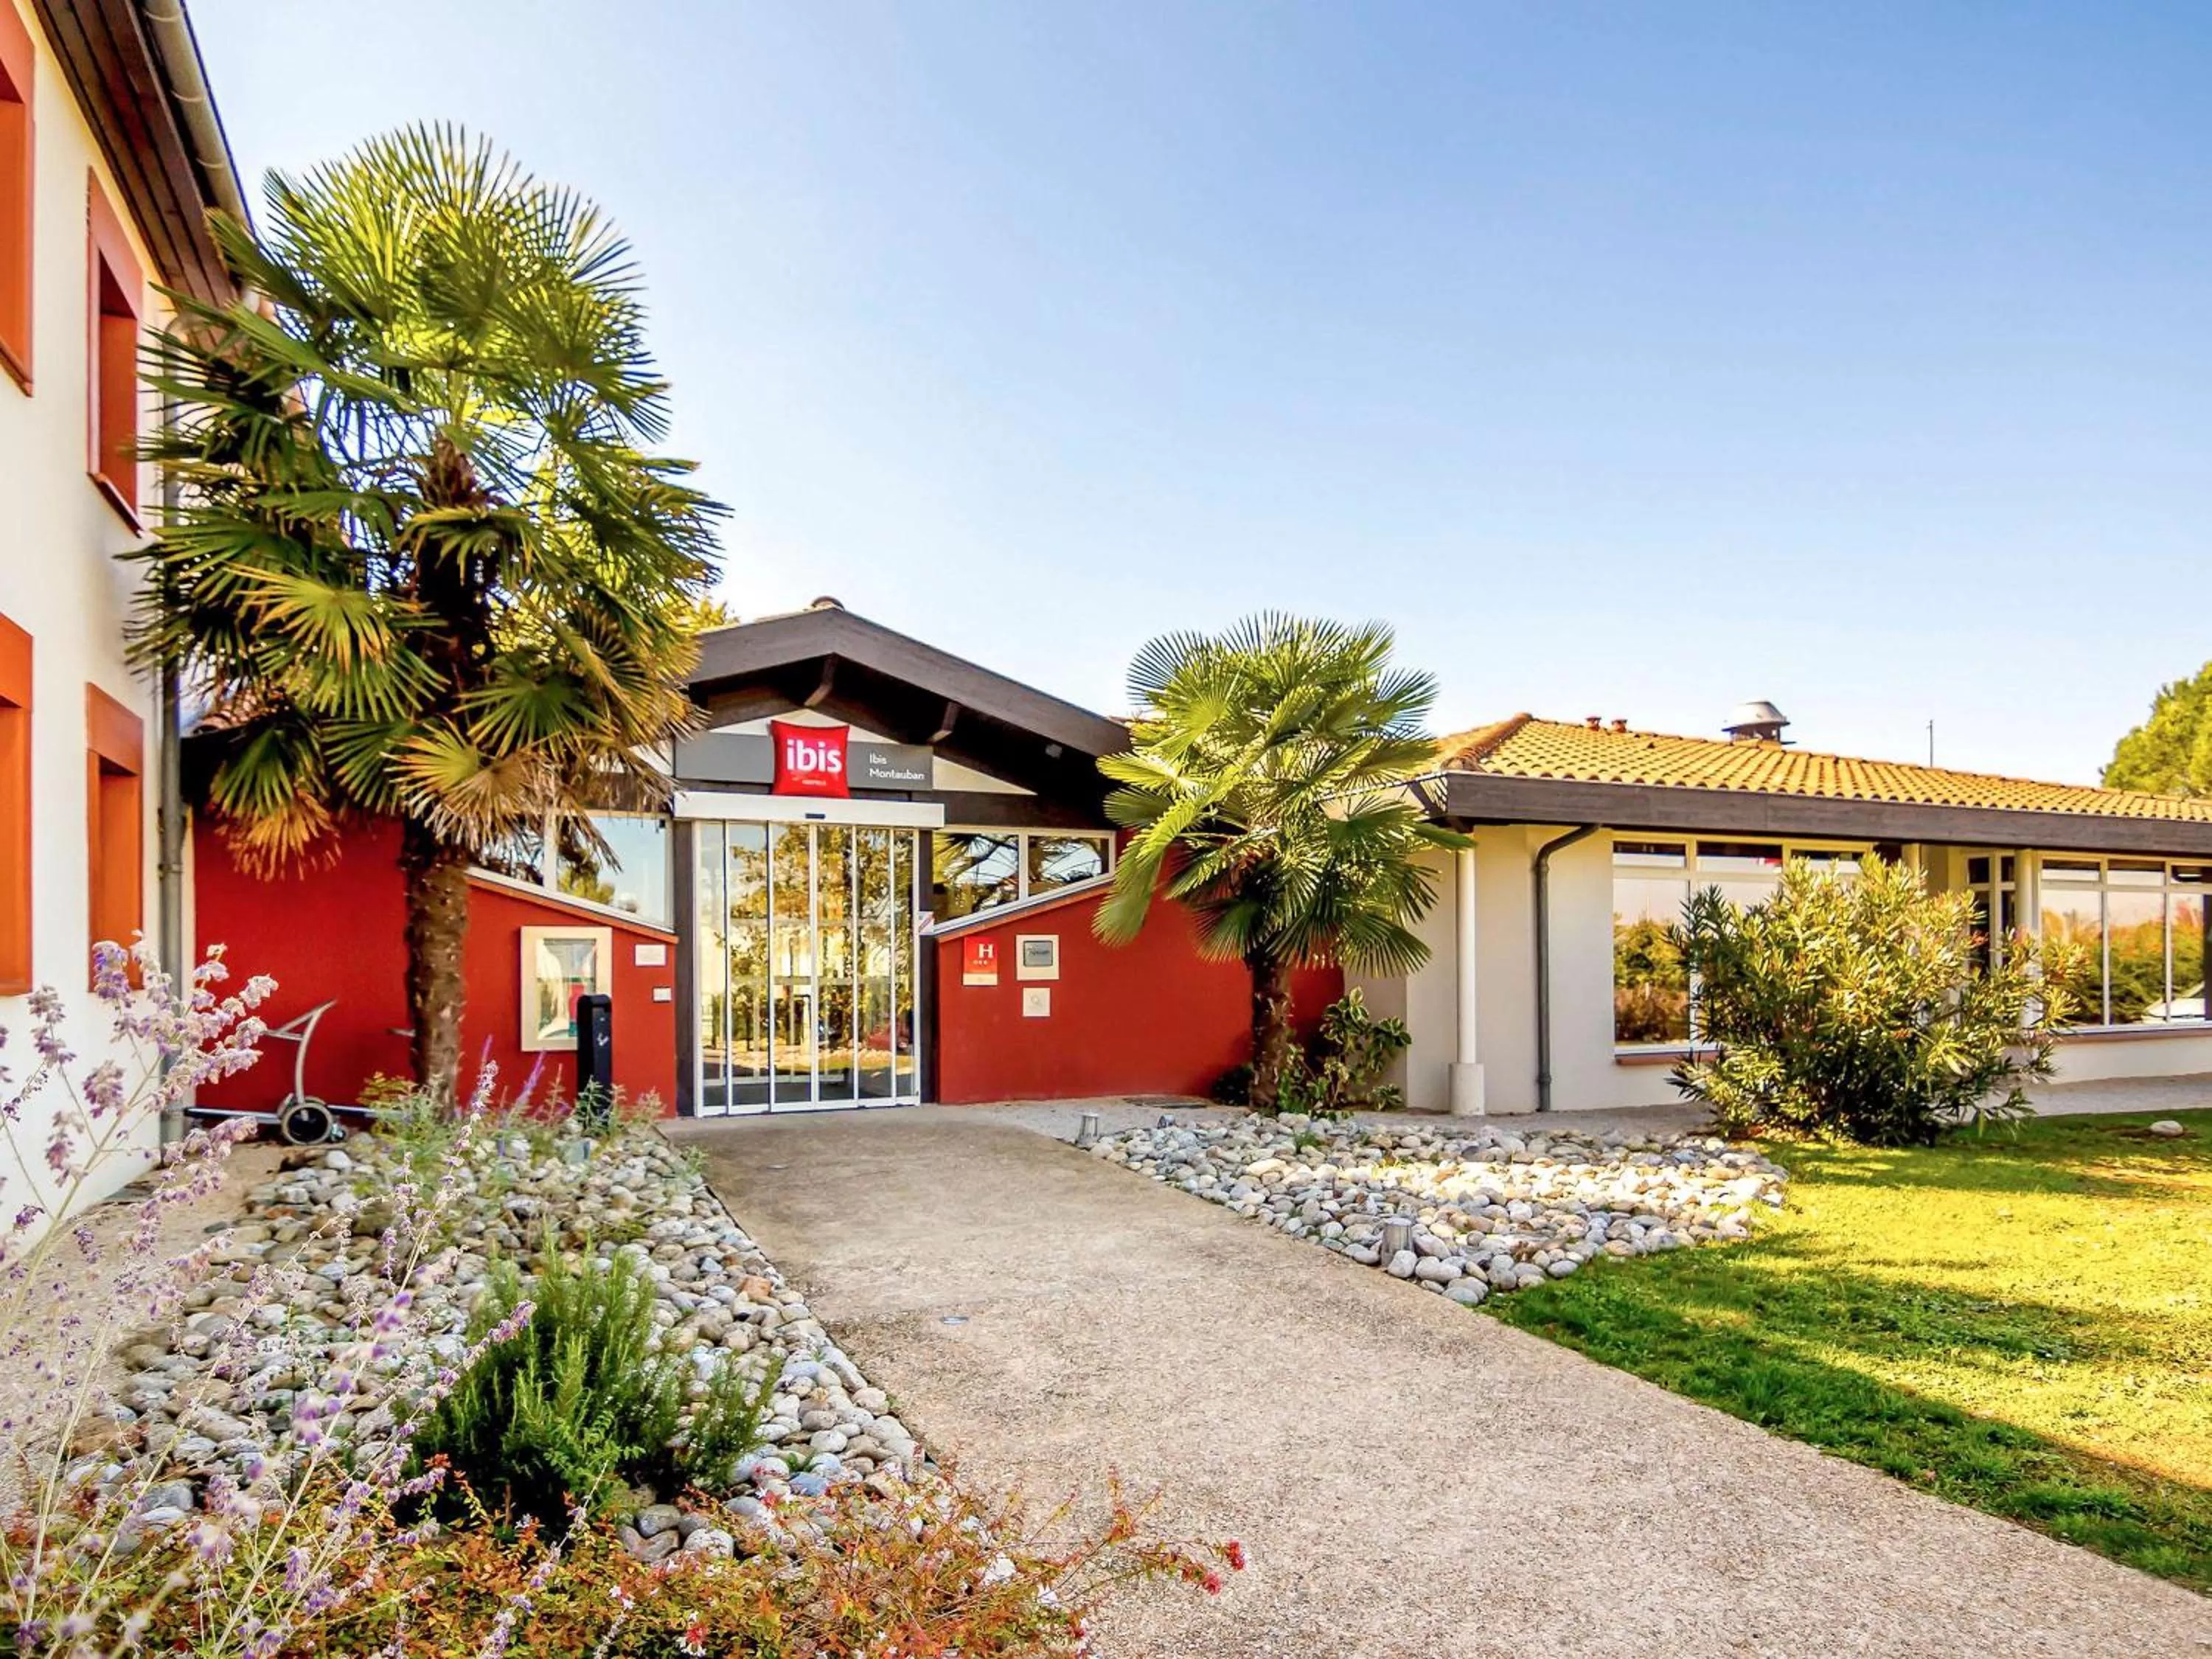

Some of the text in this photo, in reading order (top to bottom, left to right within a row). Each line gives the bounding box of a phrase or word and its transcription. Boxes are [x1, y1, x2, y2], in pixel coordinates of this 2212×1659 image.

[787, 739, 842, 773] ibis
[869, 752, 887, 765] Ibis
[869, 768, 925, 779] Montauban
[978, 943, 993, 959] H
